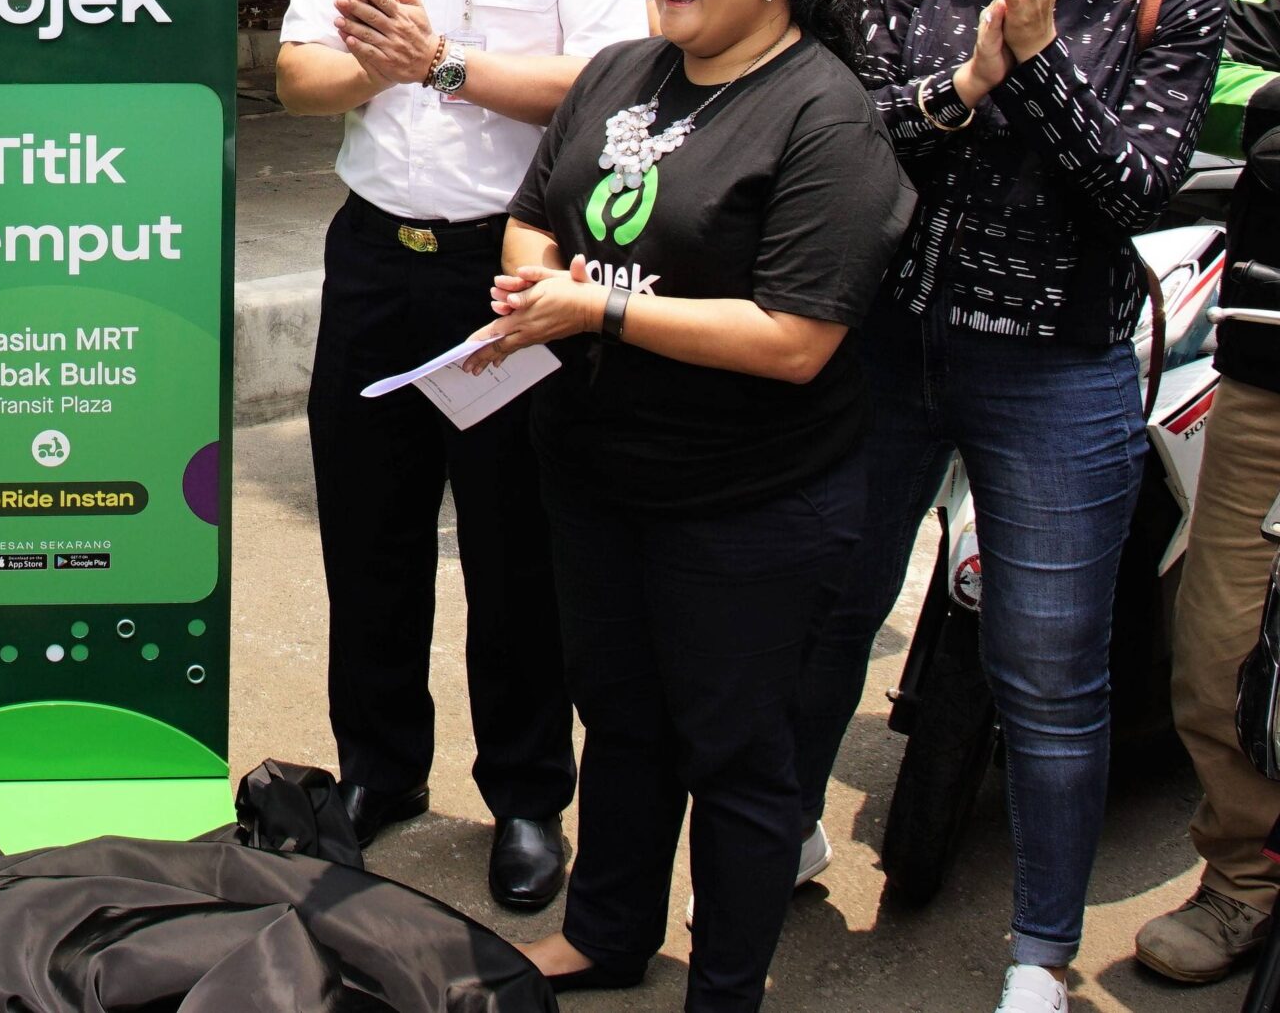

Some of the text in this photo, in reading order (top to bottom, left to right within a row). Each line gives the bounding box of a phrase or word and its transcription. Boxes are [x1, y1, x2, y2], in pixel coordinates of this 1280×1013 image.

[76, 327, 139, 350] MRT
[61, 362, 137, 386] Bulus
[61, 396, 112, 413] Plaza
[1184, 416, 1207, 440] HO
[60, 490, 134, 507] Instan
[40, 540, 111, 549] SEKARANG
